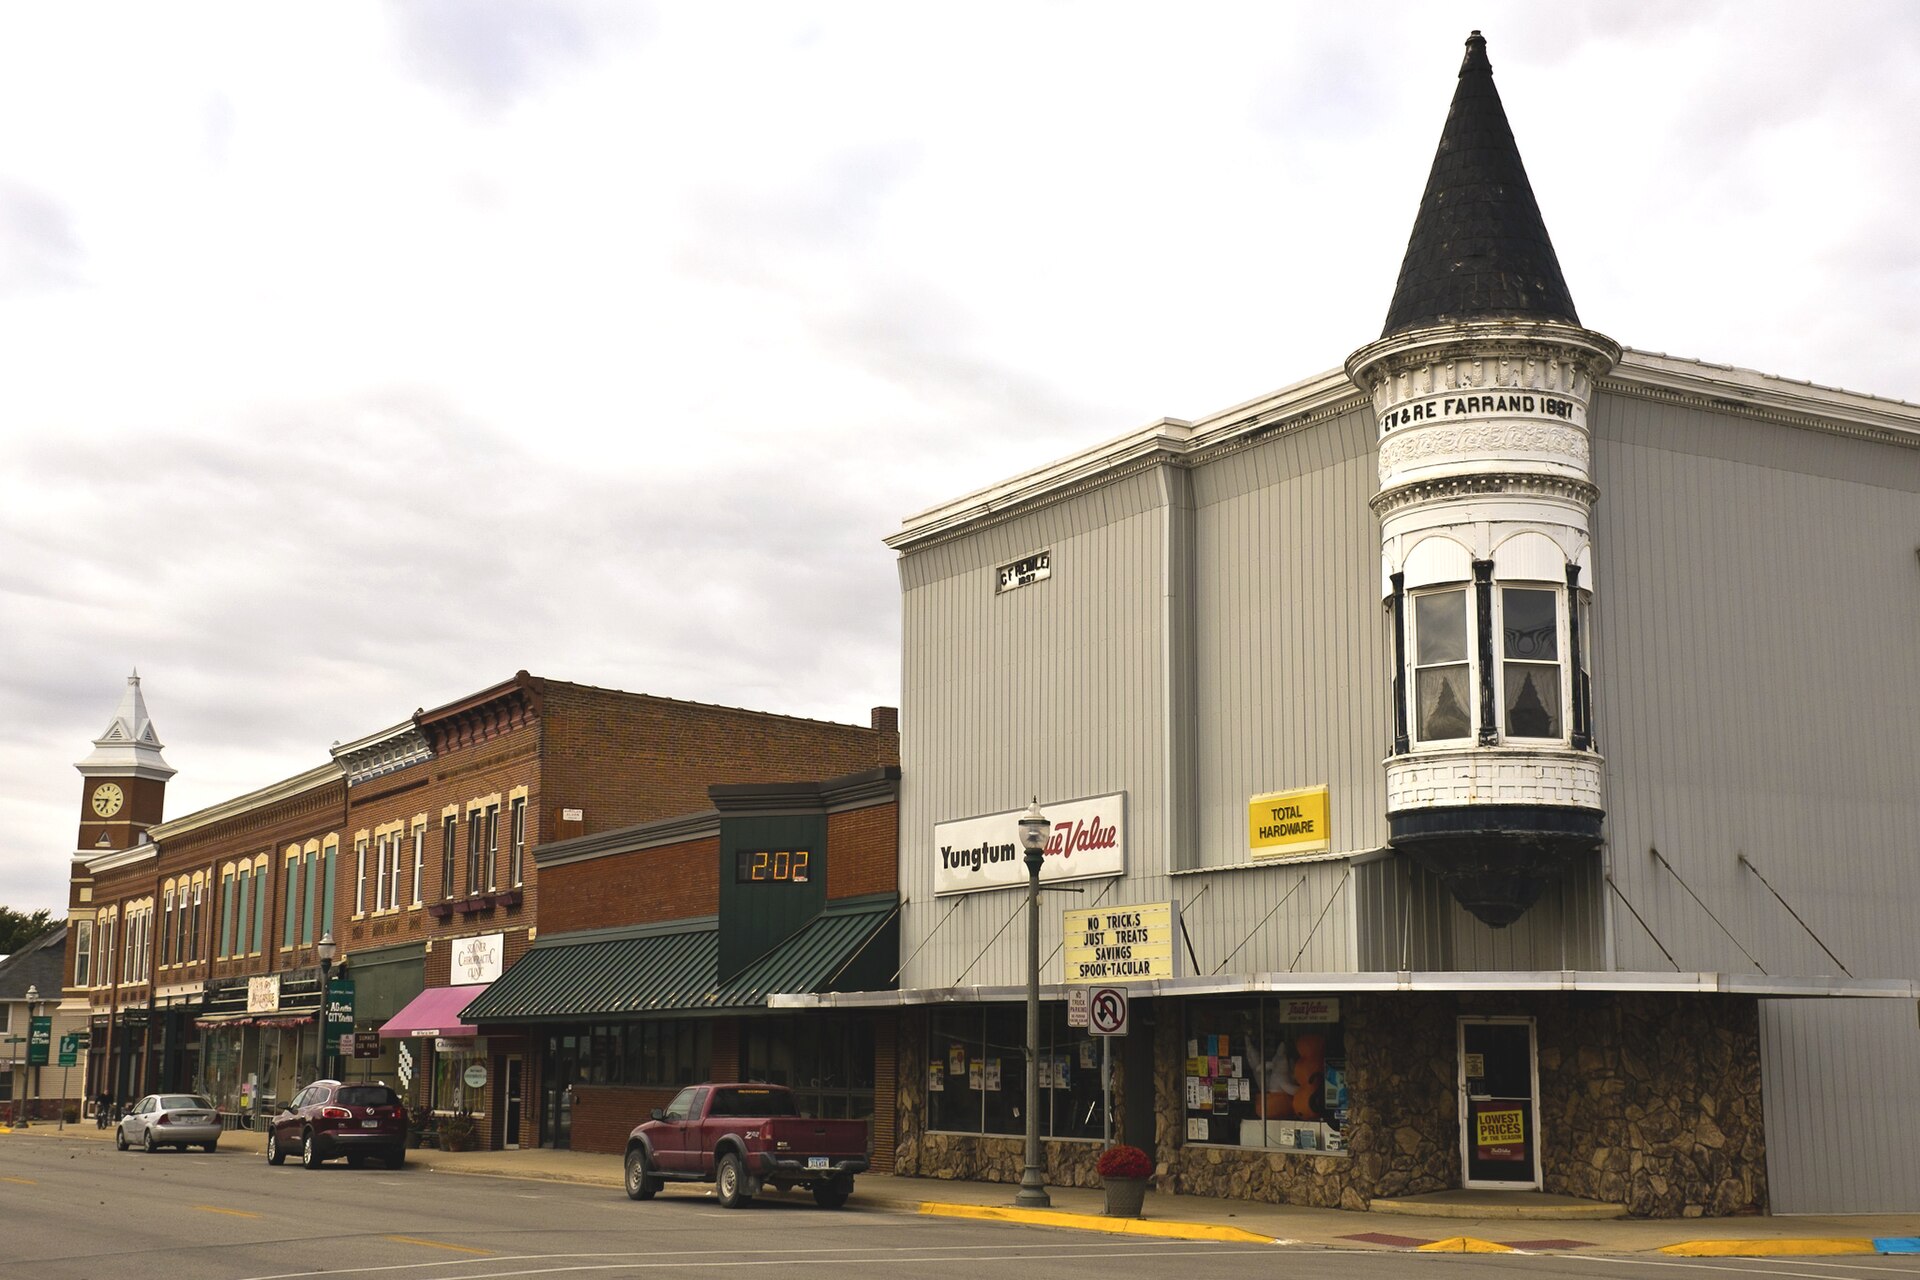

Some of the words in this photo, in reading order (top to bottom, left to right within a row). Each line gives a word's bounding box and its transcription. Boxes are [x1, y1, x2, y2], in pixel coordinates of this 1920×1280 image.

[1444, 396, 1535, 416] FARRAND
[1541, 397, 1573, 418] 1887
[1271, 805, 1303, 821] TOTAL
[1259, 820, 1314, 839] HARDWARE
[940, 842, 1015, 871] Yungtum
[1055, 815, 1117, 859] Value
[752, 852, 808, 880] 2:02
[1088, 917, 1099, 930] NO
[1084, 932, 1105, 946] JUST
[1116, 929, 1148, 944] TREATS
[1095, 946, 1132, 960] SAVINGS
[1080, 961, 1150, 977] SPOOK-TACULAR
[1479, 1113, 1519, 1125] LOWEST
[1480, 1123, 1521, 1135] PRICES
